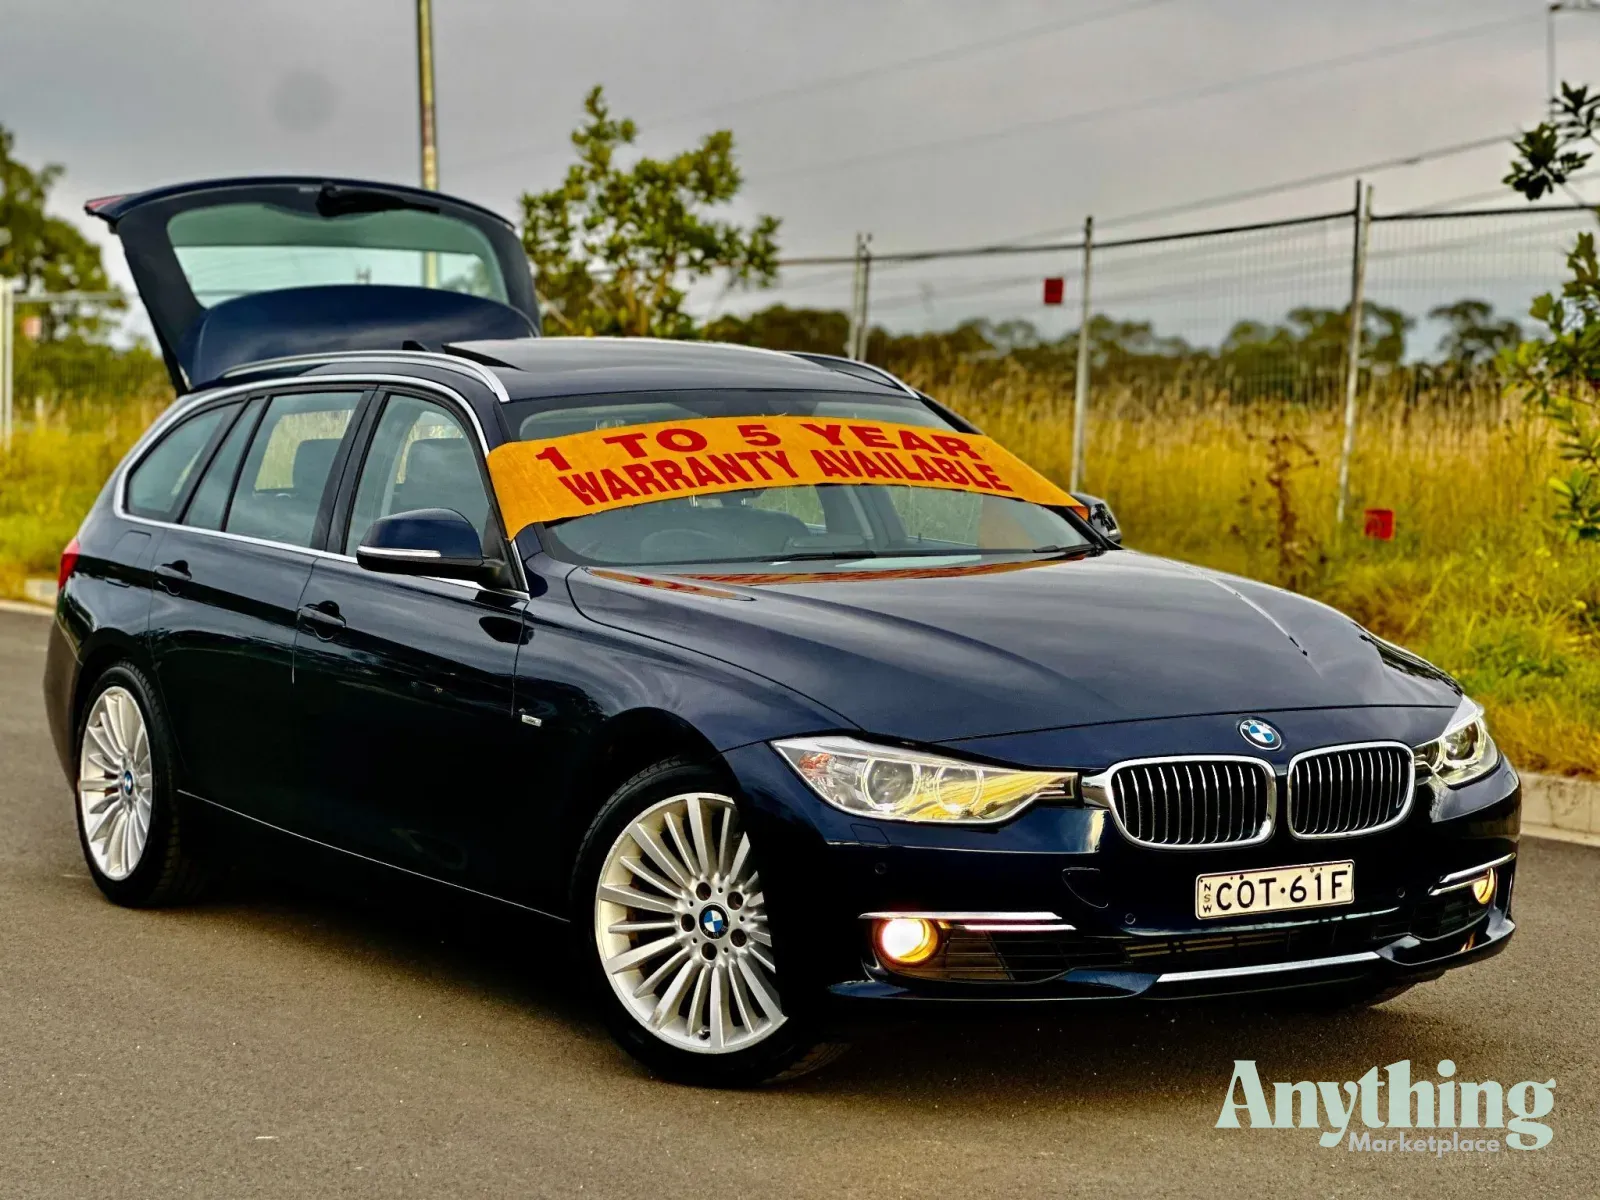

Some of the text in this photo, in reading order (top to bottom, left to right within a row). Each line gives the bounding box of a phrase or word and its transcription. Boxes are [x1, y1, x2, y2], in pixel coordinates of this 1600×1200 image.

[535, 423, 983, 472] 1 TO 5 YEAR
[558, 449, 1013, 506] WARRANTY AVAILABLE
